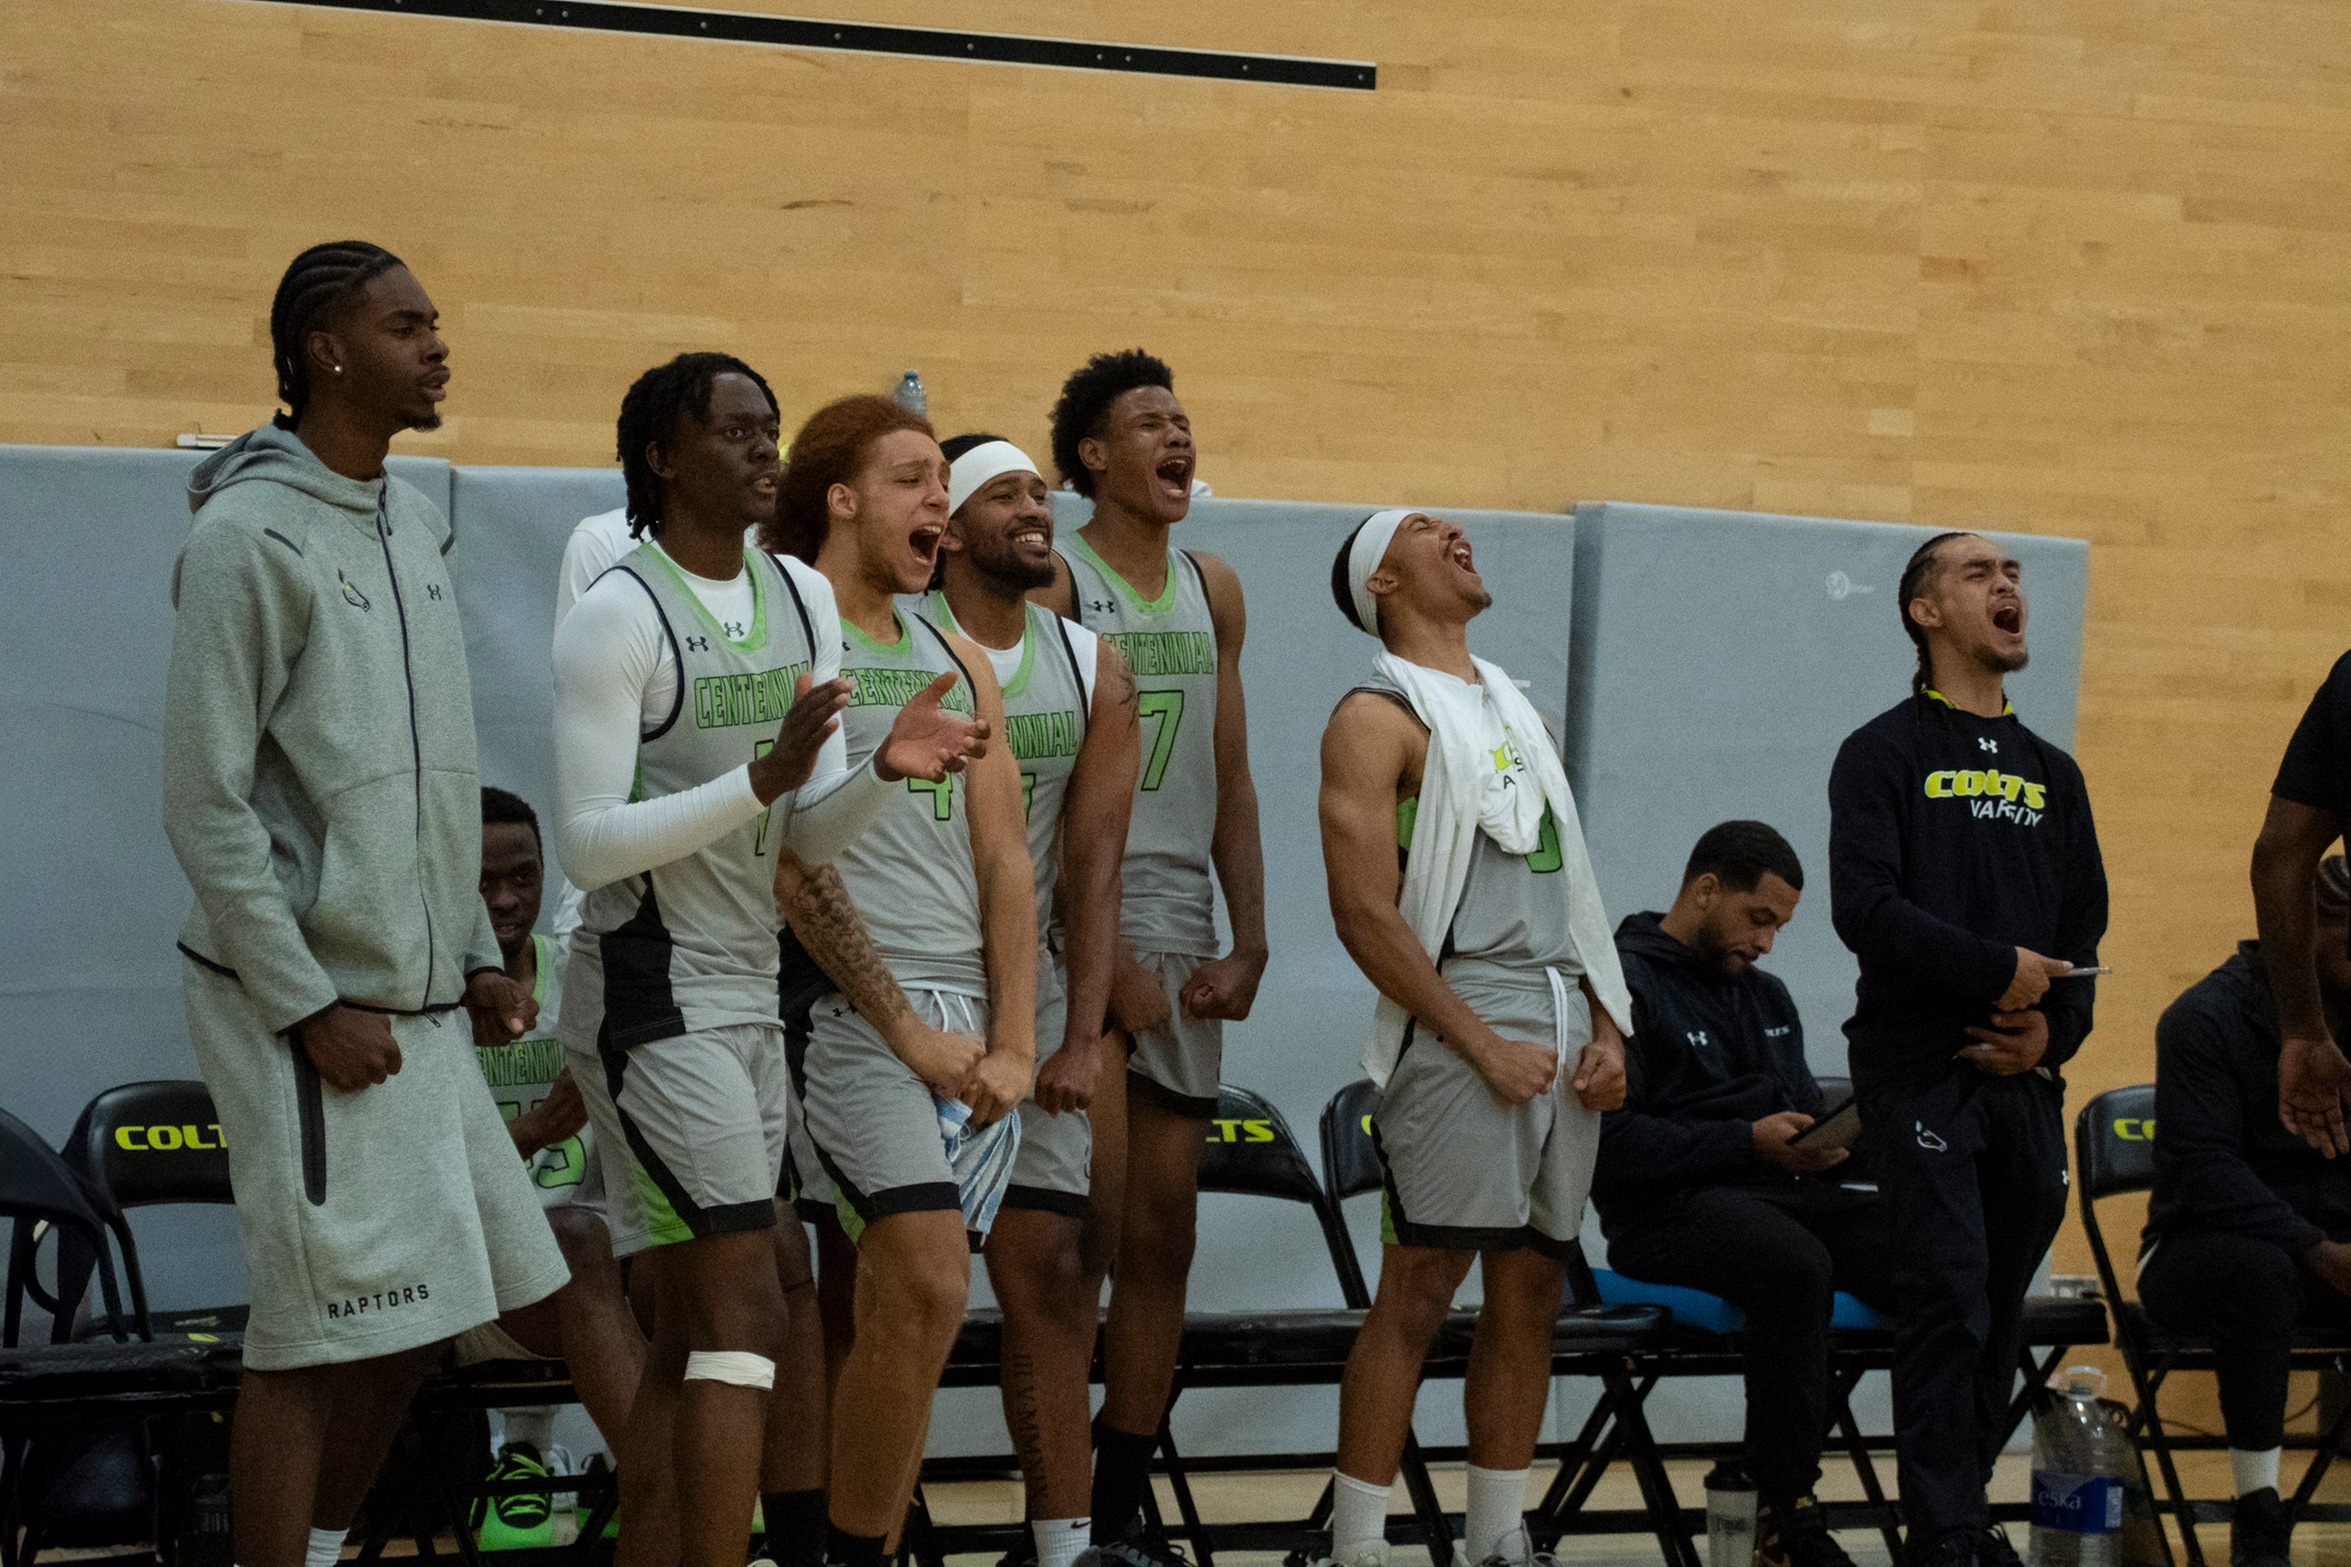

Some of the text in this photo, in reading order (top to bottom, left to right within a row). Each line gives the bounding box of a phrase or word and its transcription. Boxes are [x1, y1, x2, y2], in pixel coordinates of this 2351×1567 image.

[1101, 632, 1213, 675] ENTENNIAL
[694, 660, 809, 729] CENTENNI
[1004, 711, 1078, 759] NNIAL
[1137, 689, 1185, 791] 7
[1924, 769, 2047, 809] COLTS
[1205, 1119, 1275, 1143] TS
[327, 1283, 430, 1319] RAPTORS
